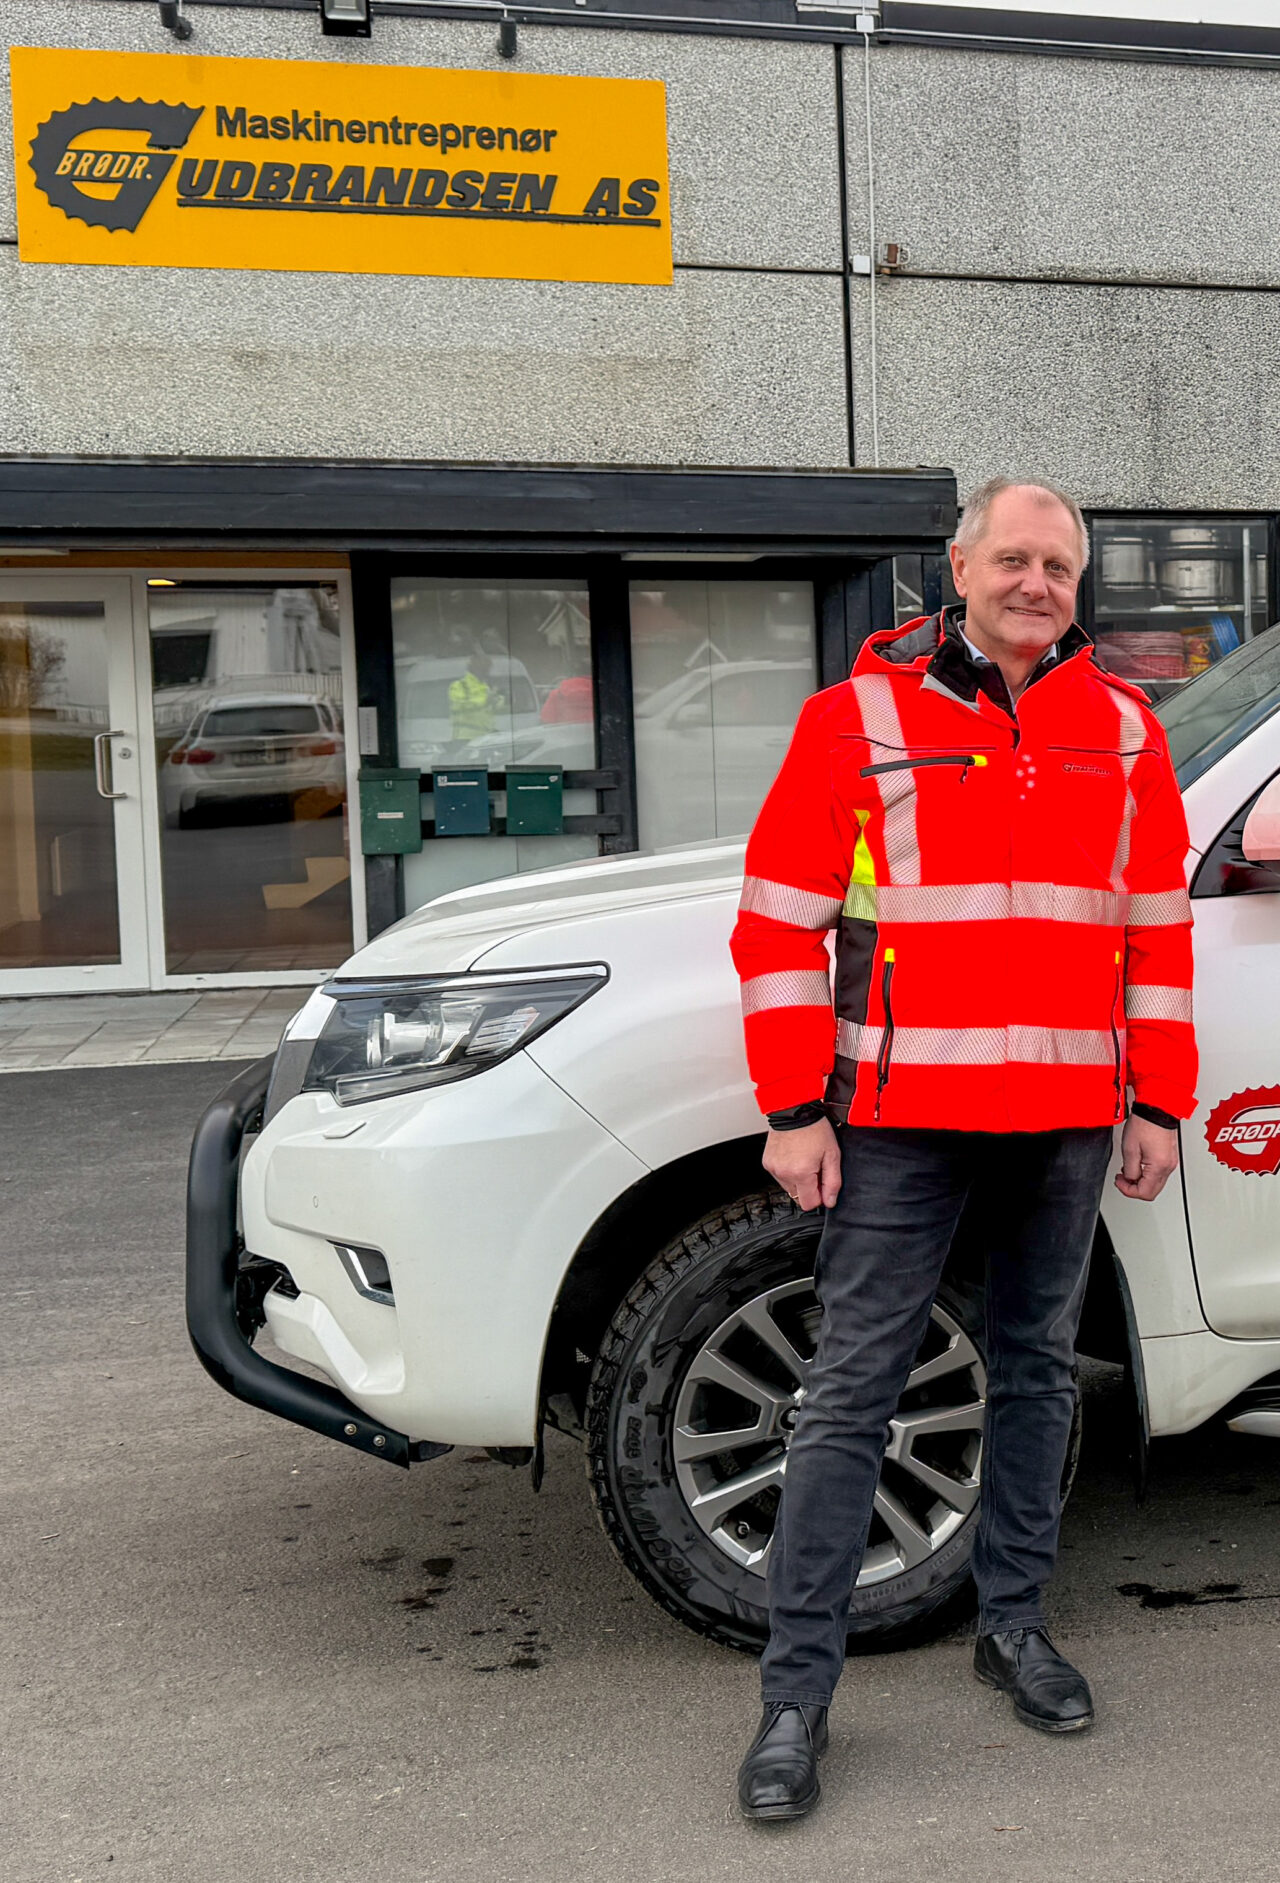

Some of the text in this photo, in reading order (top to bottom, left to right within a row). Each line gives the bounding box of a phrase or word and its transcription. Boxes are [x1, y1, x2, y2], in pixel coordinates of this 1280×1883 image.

[215, 106, 557, 155] Maskinentreprenør
[55, 151, 154, 181] BRØDR.
[582, 176, 660, 217] AS
